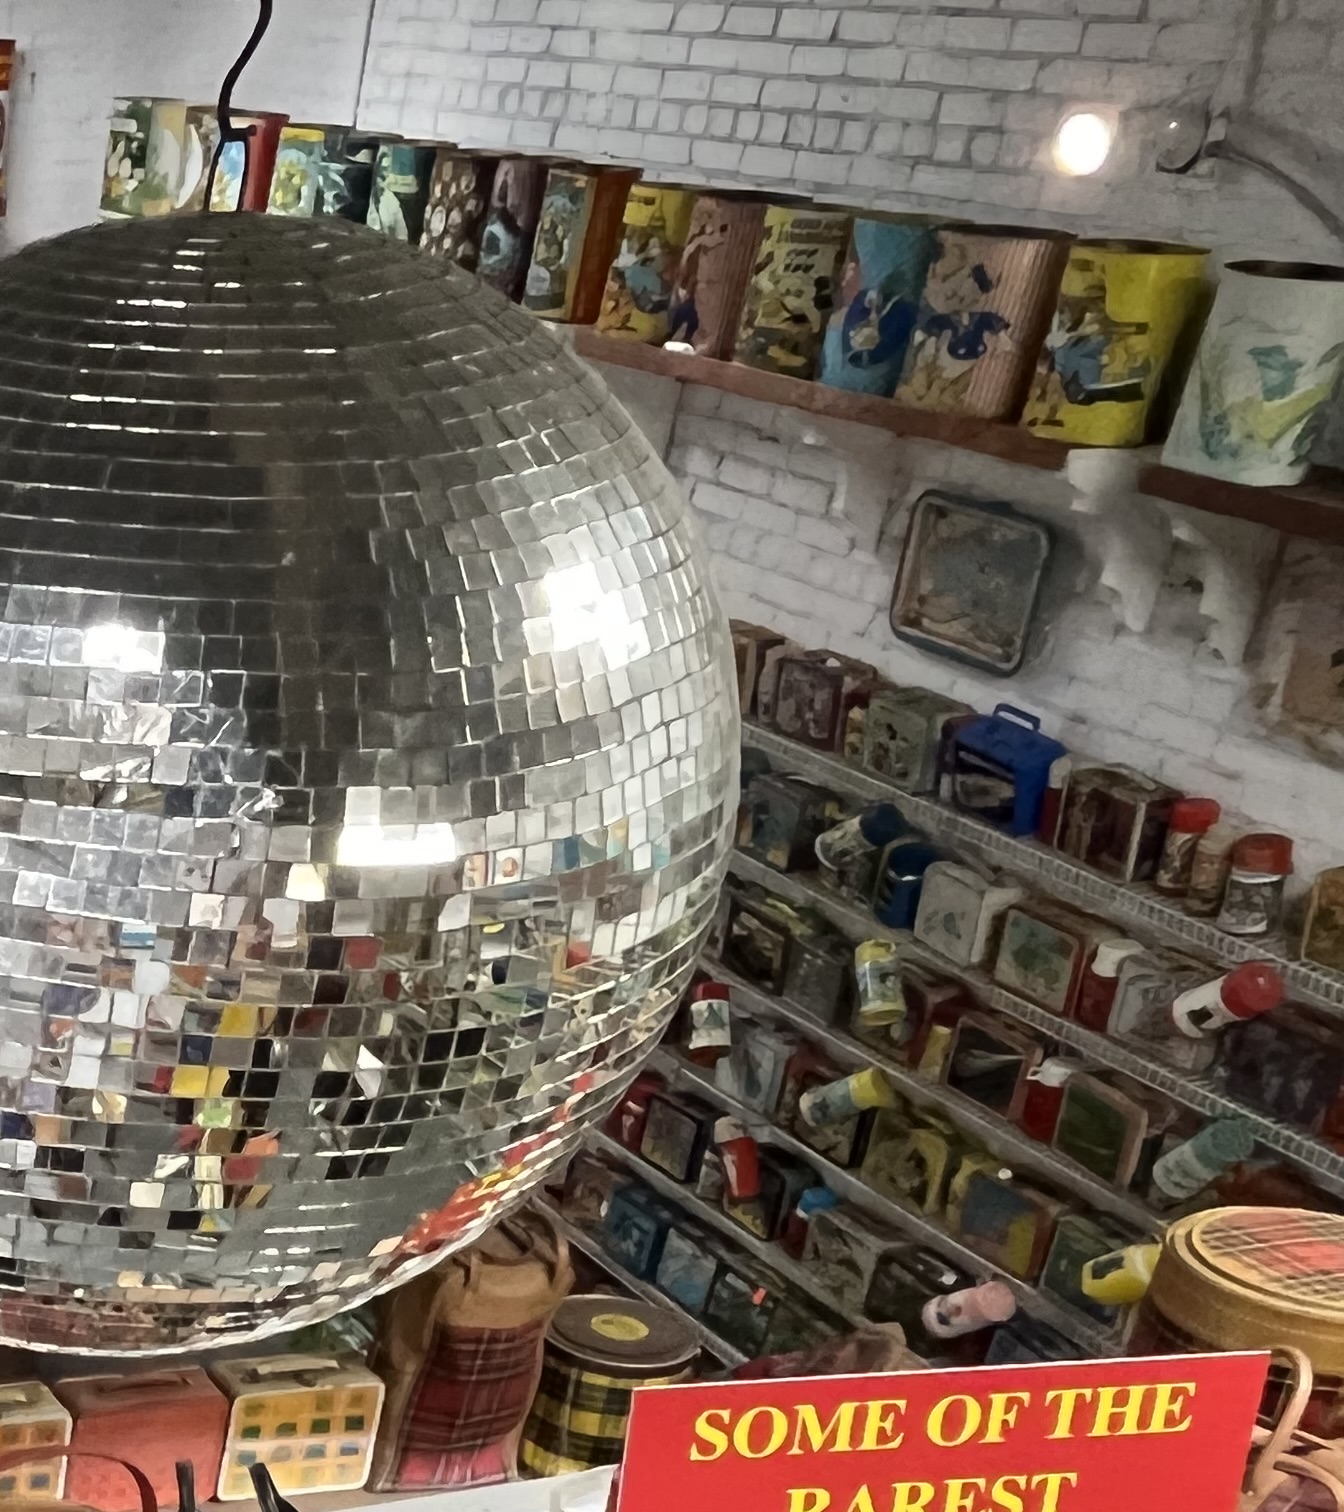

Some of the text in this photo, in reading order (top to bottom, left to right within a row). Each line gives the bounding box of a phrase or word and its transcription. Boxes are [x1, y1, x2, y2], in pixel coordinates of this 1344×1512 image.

[690, 1382, 1197, 1461] SOME OF THE
